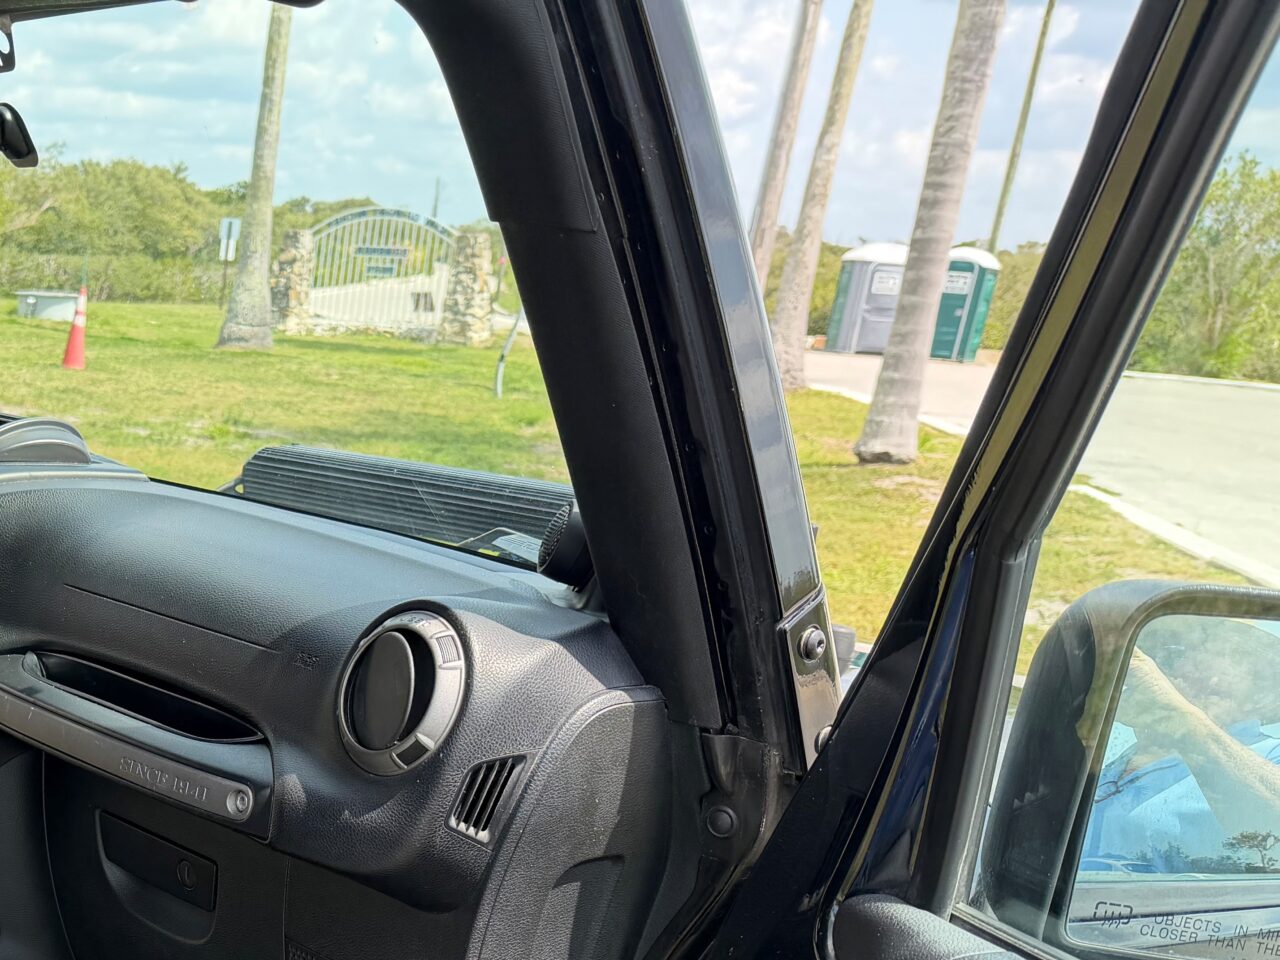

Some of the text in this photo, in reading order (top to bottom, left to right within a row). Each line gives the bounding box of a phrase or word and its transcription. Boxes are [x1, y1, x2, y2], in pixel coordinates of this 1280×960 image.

[119, 757, 169, 784] SINCE
[1139, 923, 1198, 942] CLOSER
[1207, 934, 1246, 951] THAN
[1153, 914, 1222, 934] OBJECTS
[1233, 924, 1249, 937] IN
